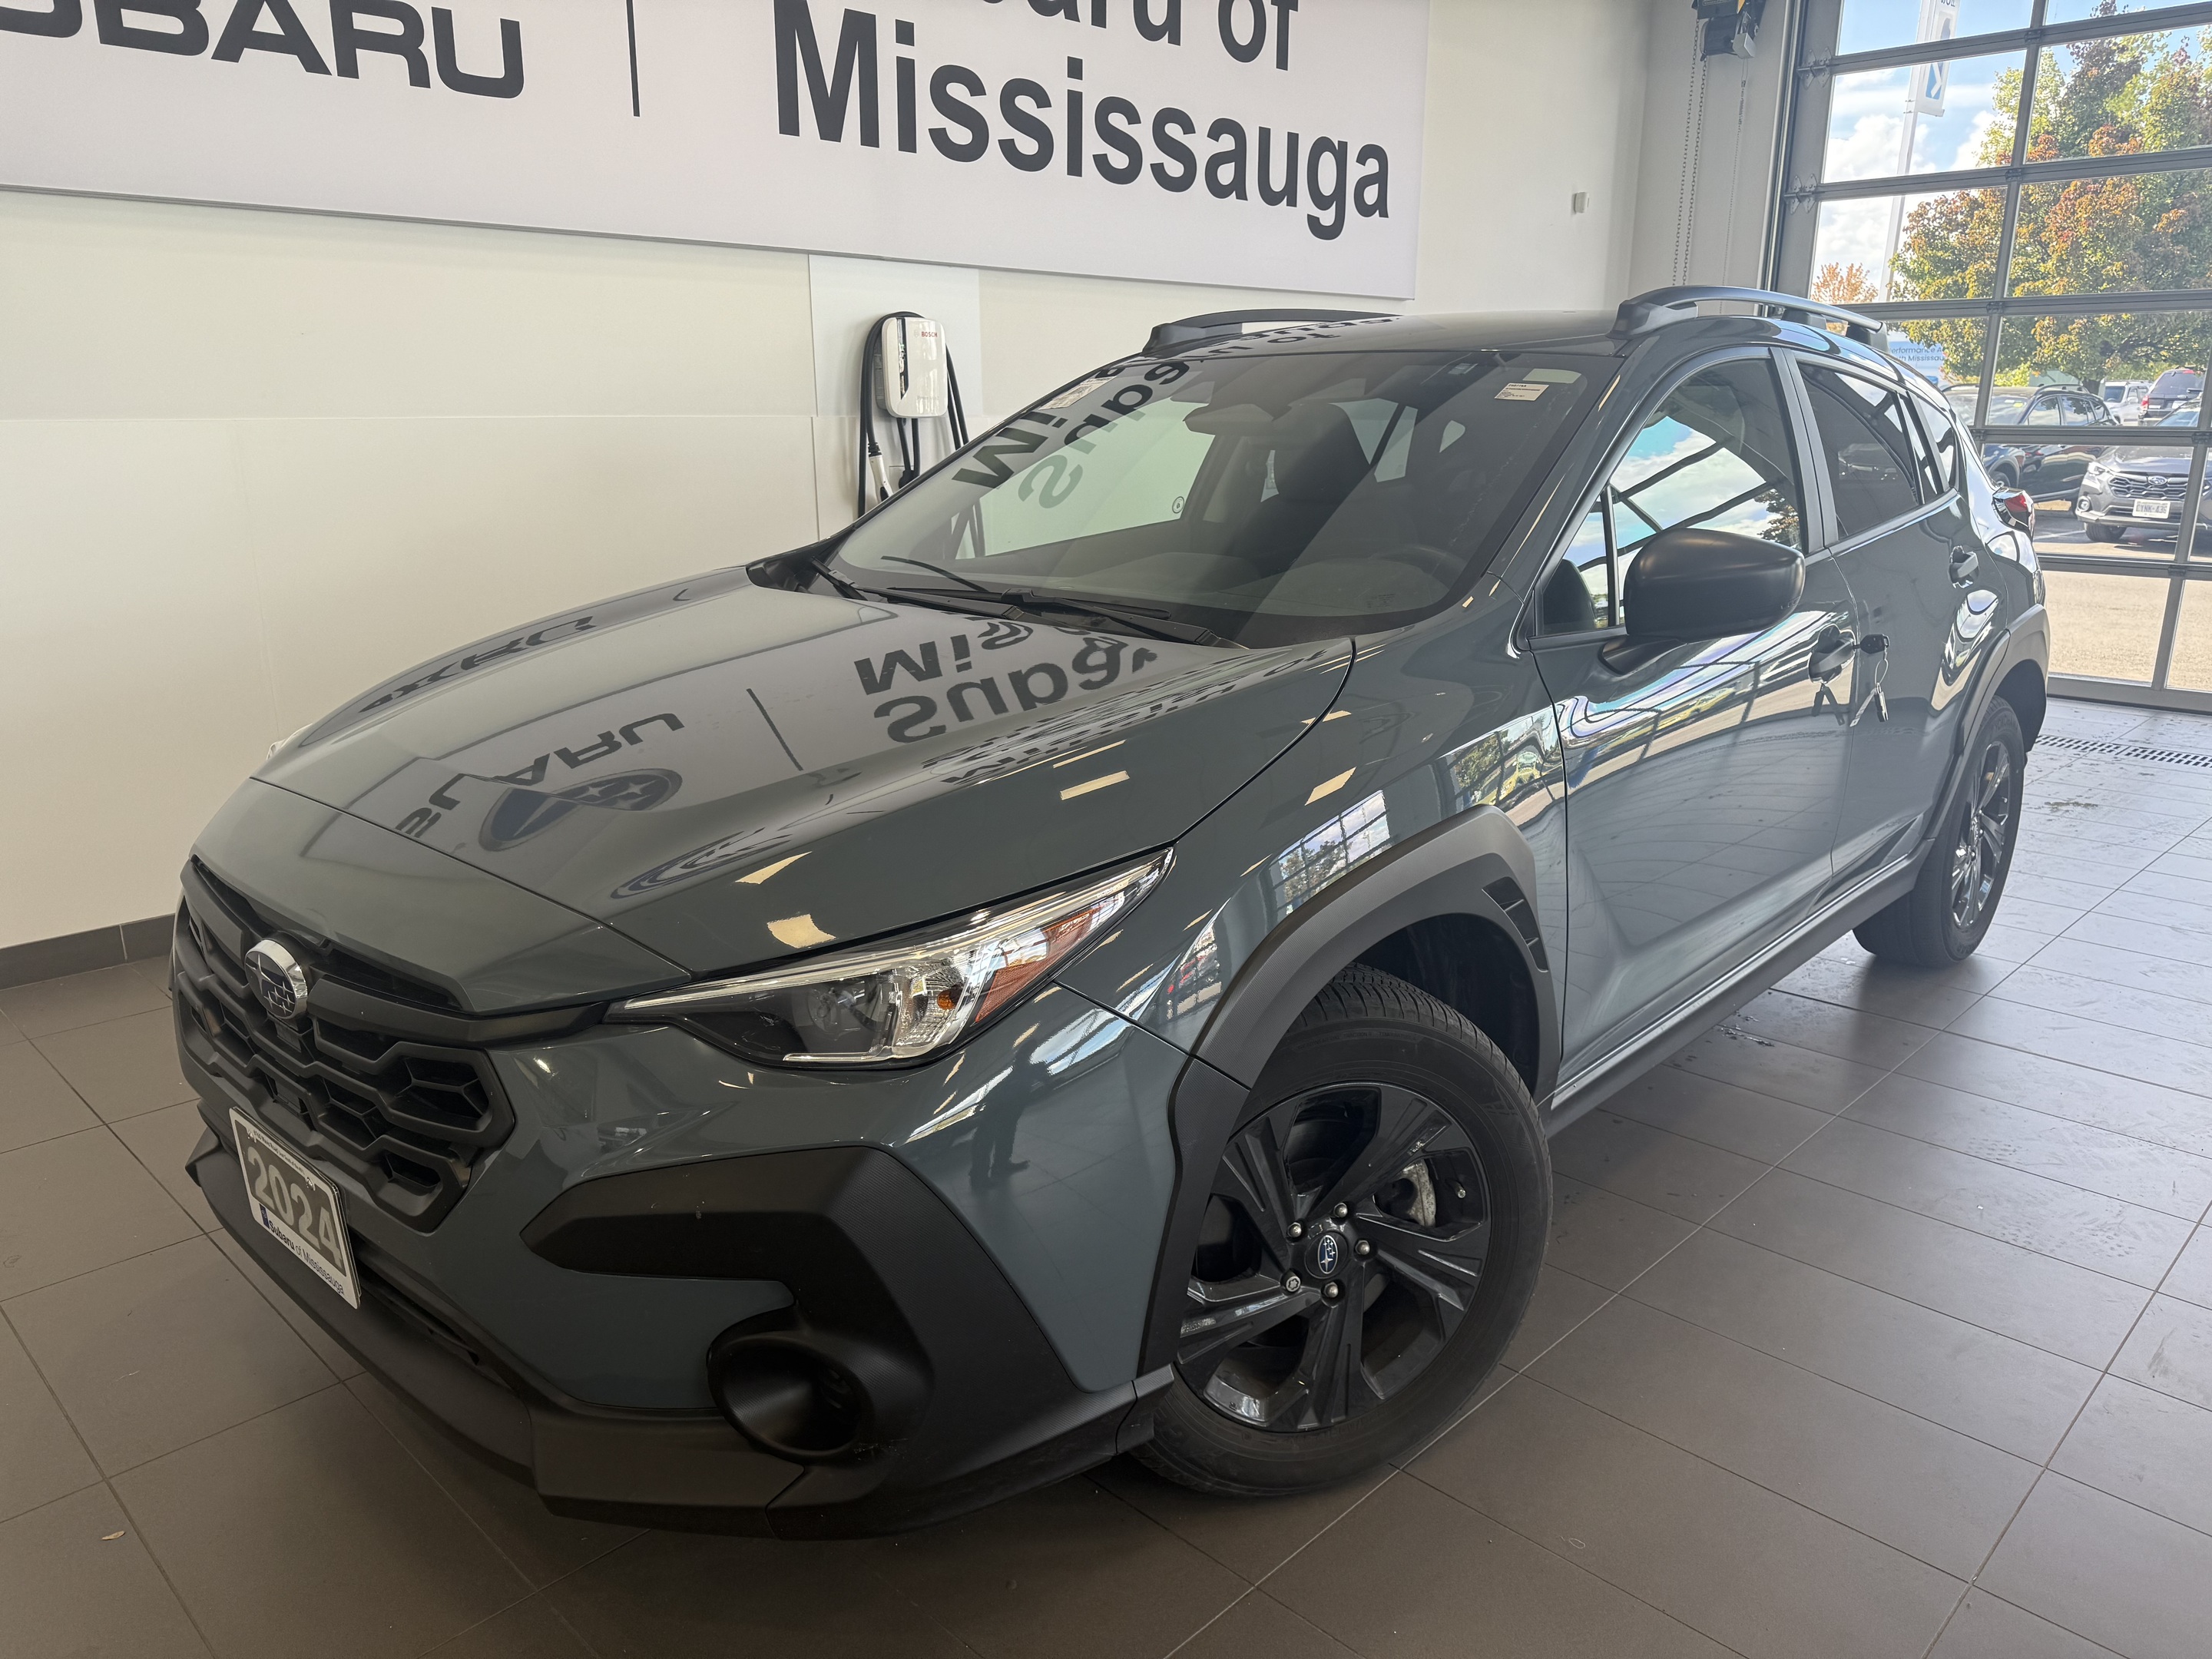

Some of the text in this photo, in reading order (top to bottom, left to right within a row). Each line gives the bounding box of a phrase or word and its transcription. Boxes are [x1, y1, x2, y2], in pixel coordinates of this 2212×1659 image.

[773, 0, 1389, 240] Mississauga
[248, 1147, 343, 1269] 2024
[269, 1220, 295, 1250] Subaru
[303, 1248, 344, 1295] Mississauga
